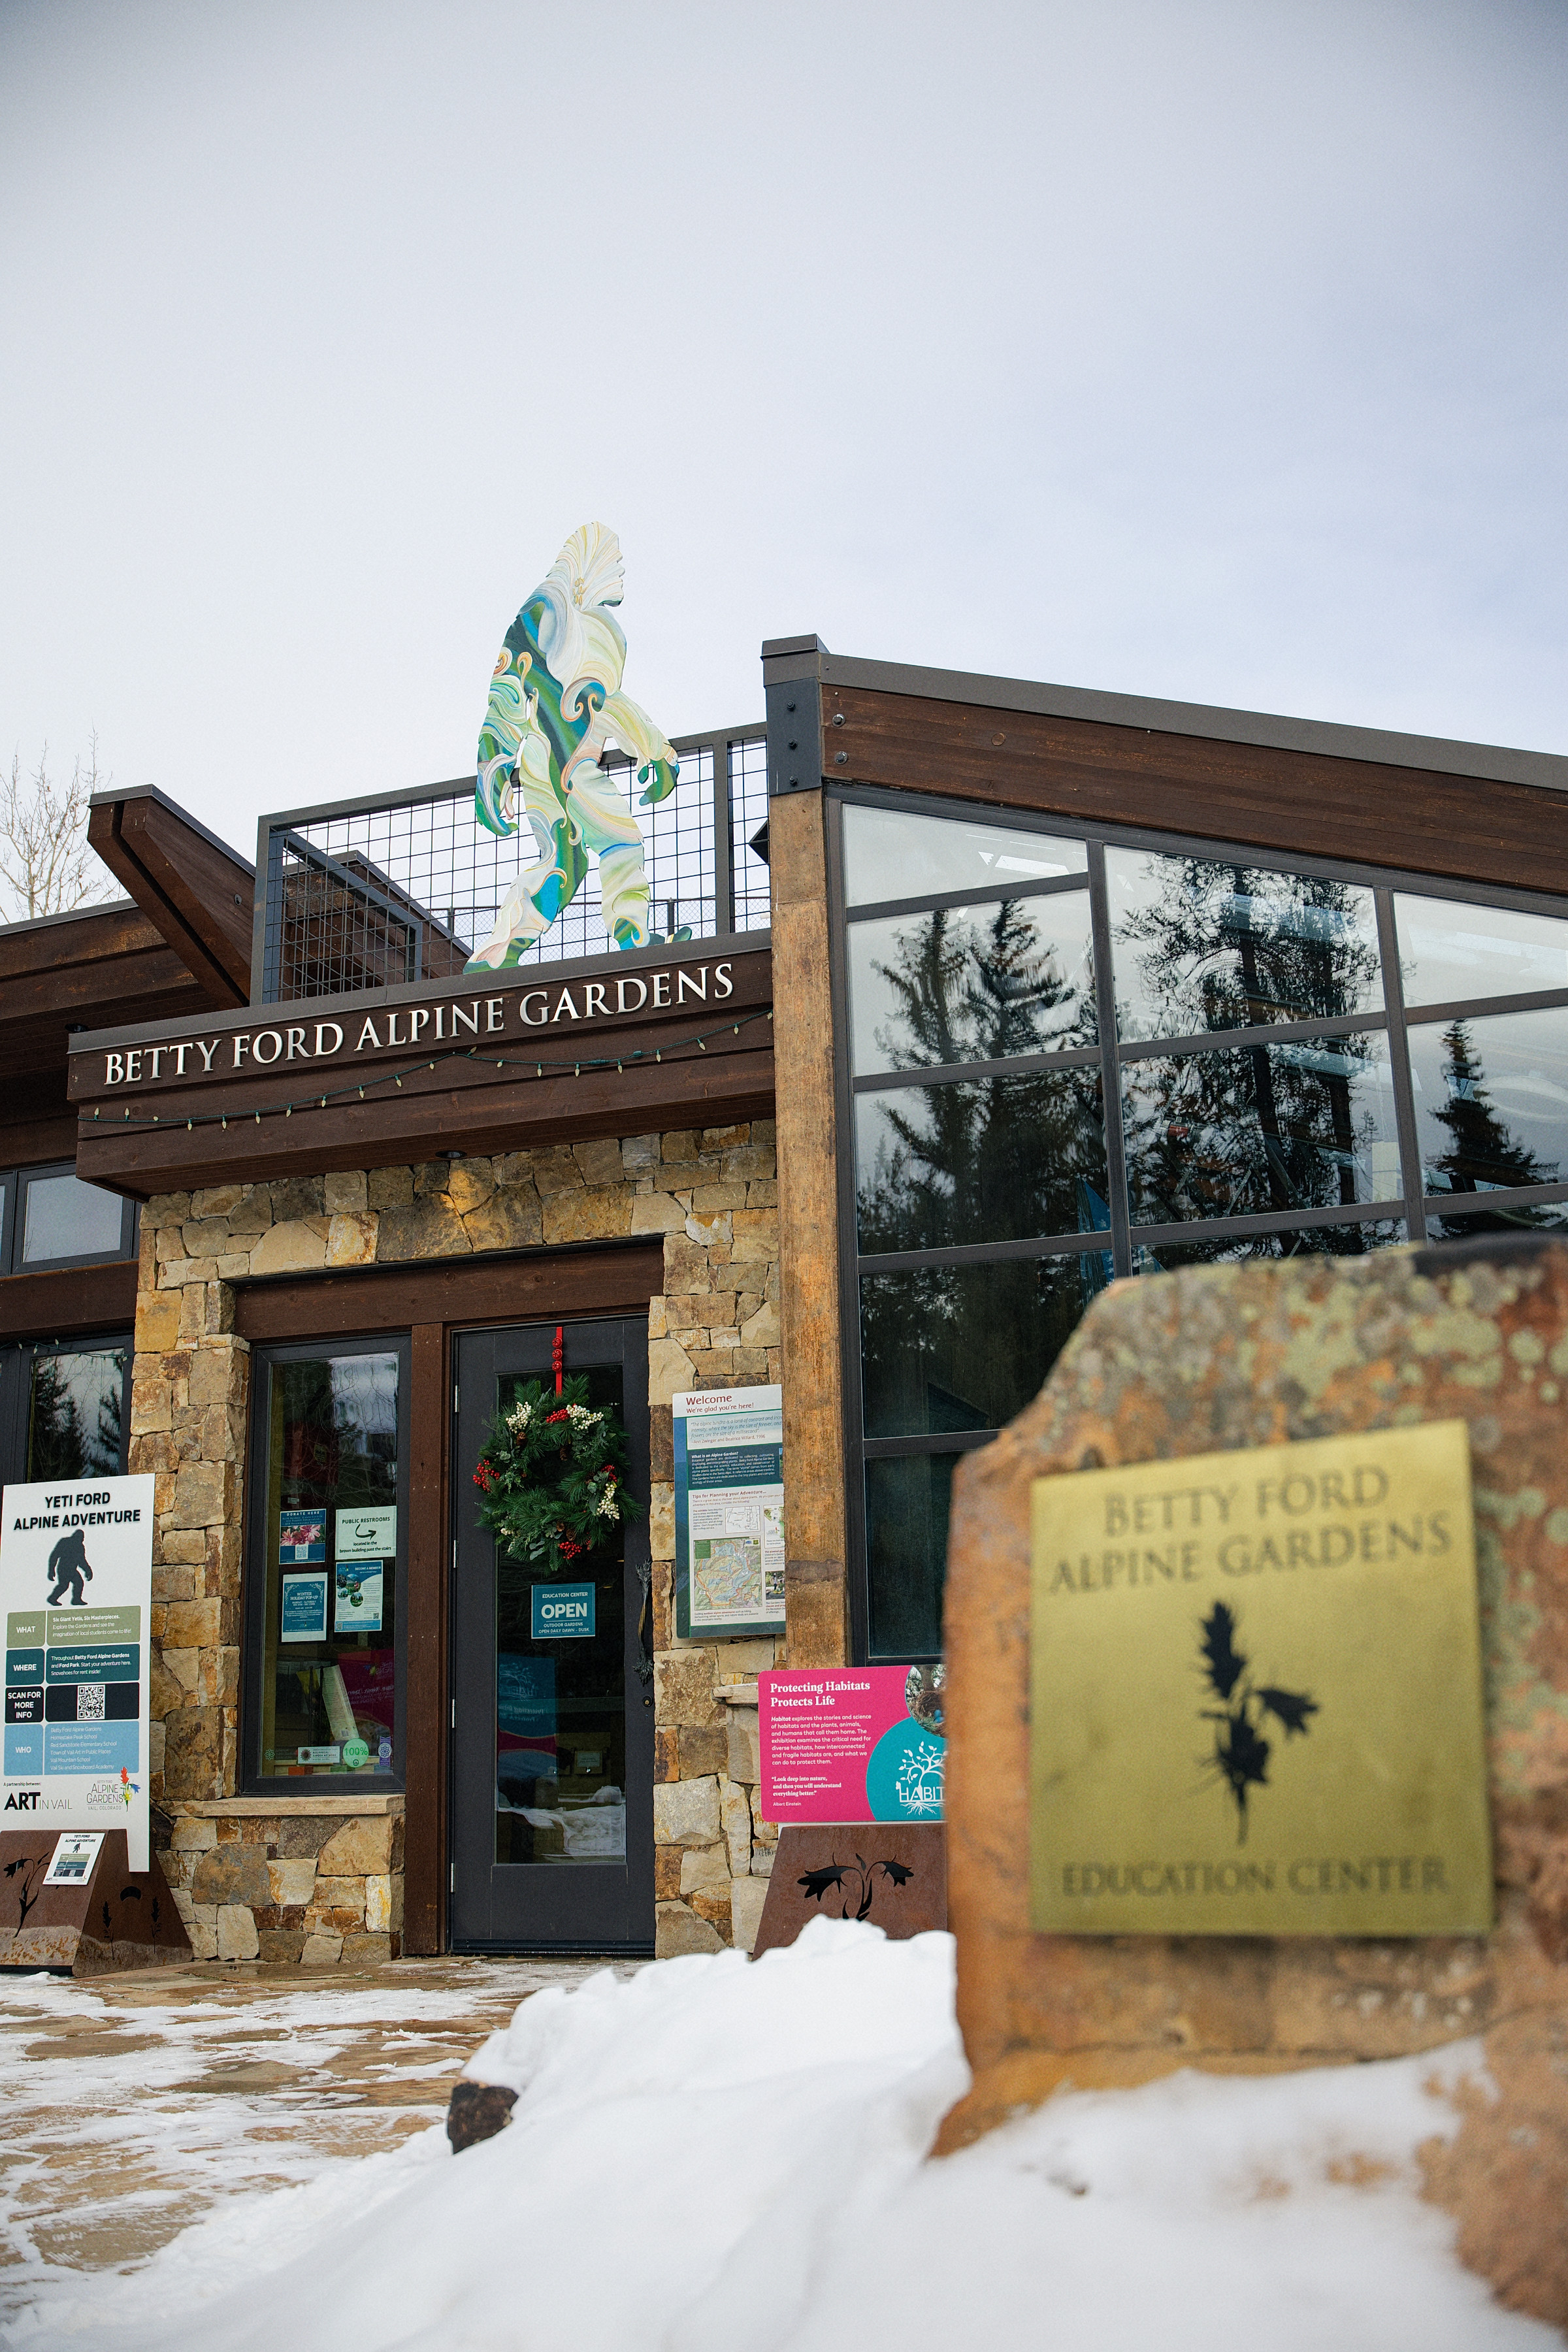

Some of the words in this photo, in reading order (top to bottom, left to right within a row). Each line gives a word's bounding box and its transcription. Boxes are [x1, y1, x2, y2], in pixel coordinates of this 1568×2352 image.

[103, 1037, 221, 1088] BETTY
[231, 1022, 345, 1068] FORD
[353, 997, 506, 1051] ALPINE
[519, 962, 735, 1026] GARDENS
[686, 1395, 732, 1405] Welcome
[45, 1495, 73, 1508] YETI
[76, 1492, 110, 1506] FORD
[1103, 1482, 1242, 1539] BETTY
[1256, 1464, 1390, 1518] FORD
[14, 1516, 59, 1530] ALPINE
[62, 1509, 140, 1527] ADVENTURE
[1048, 1541, 1201, 1595] ALPINE
[1217, 1509, 1454, 1577] GARDENS
[541, 1603, 587, 1619] OPEN
[770, 1682, 823, 1694] Protecting
[825, 1681, 870, 1691] Habitats
[770, 1697, 813, 1707] Protects
[815, 1695, 835, 1705] Life
[344, 1747, 368, 1756] 100%
[91, 1784, 118, 1793] ALPINE
[4, 1792, 41, 1810] ART
[39, 1799, 48, 1810] IN
[51, 1799, 73, 1809] VAIL
[87, 1793, 123, 1803] GARDENS
[1061, 1858, 1276, 1897] EDUCATION
[1287, 1855, 1448, 1897] CENTER
